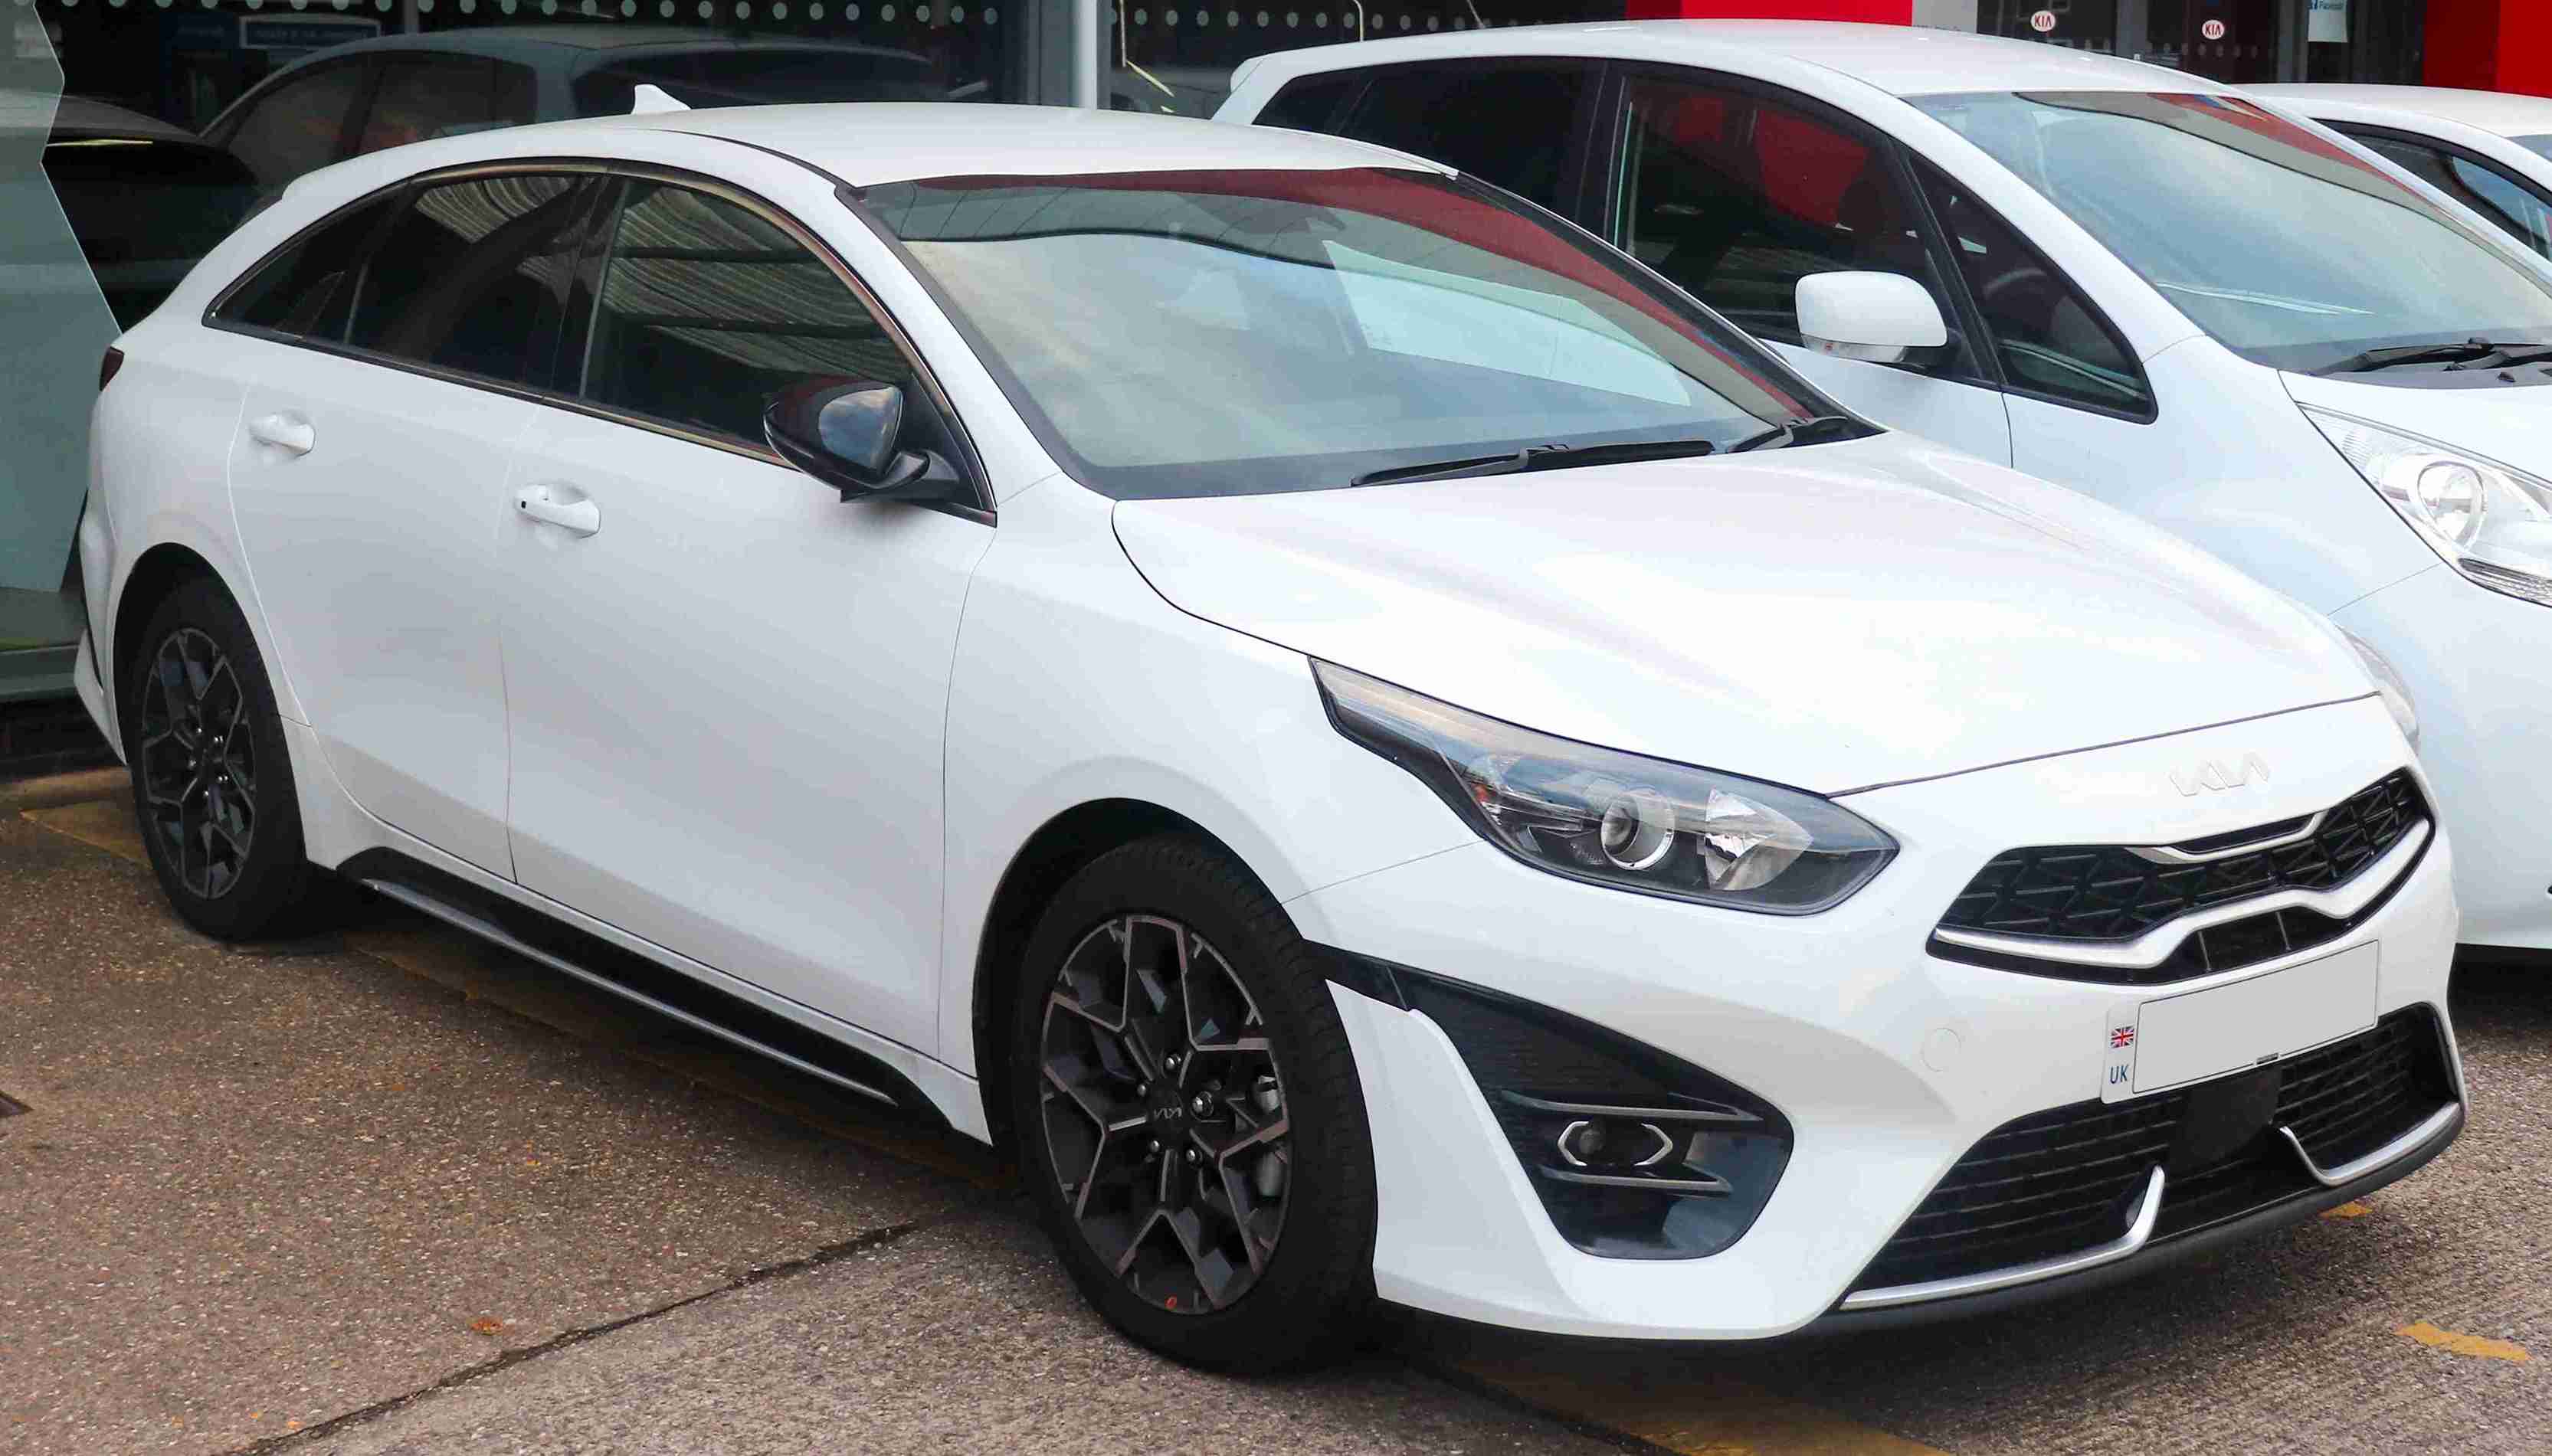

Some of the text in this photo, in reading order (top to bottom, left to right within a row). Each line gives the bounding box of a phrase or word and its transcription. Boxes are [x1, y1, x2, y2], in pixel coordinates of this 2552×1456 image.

[2035, 15, 2052, 28] KIA
[2206, 24, 2221, 36] KIA
[2110, 1064, 2129, 1084] UK
